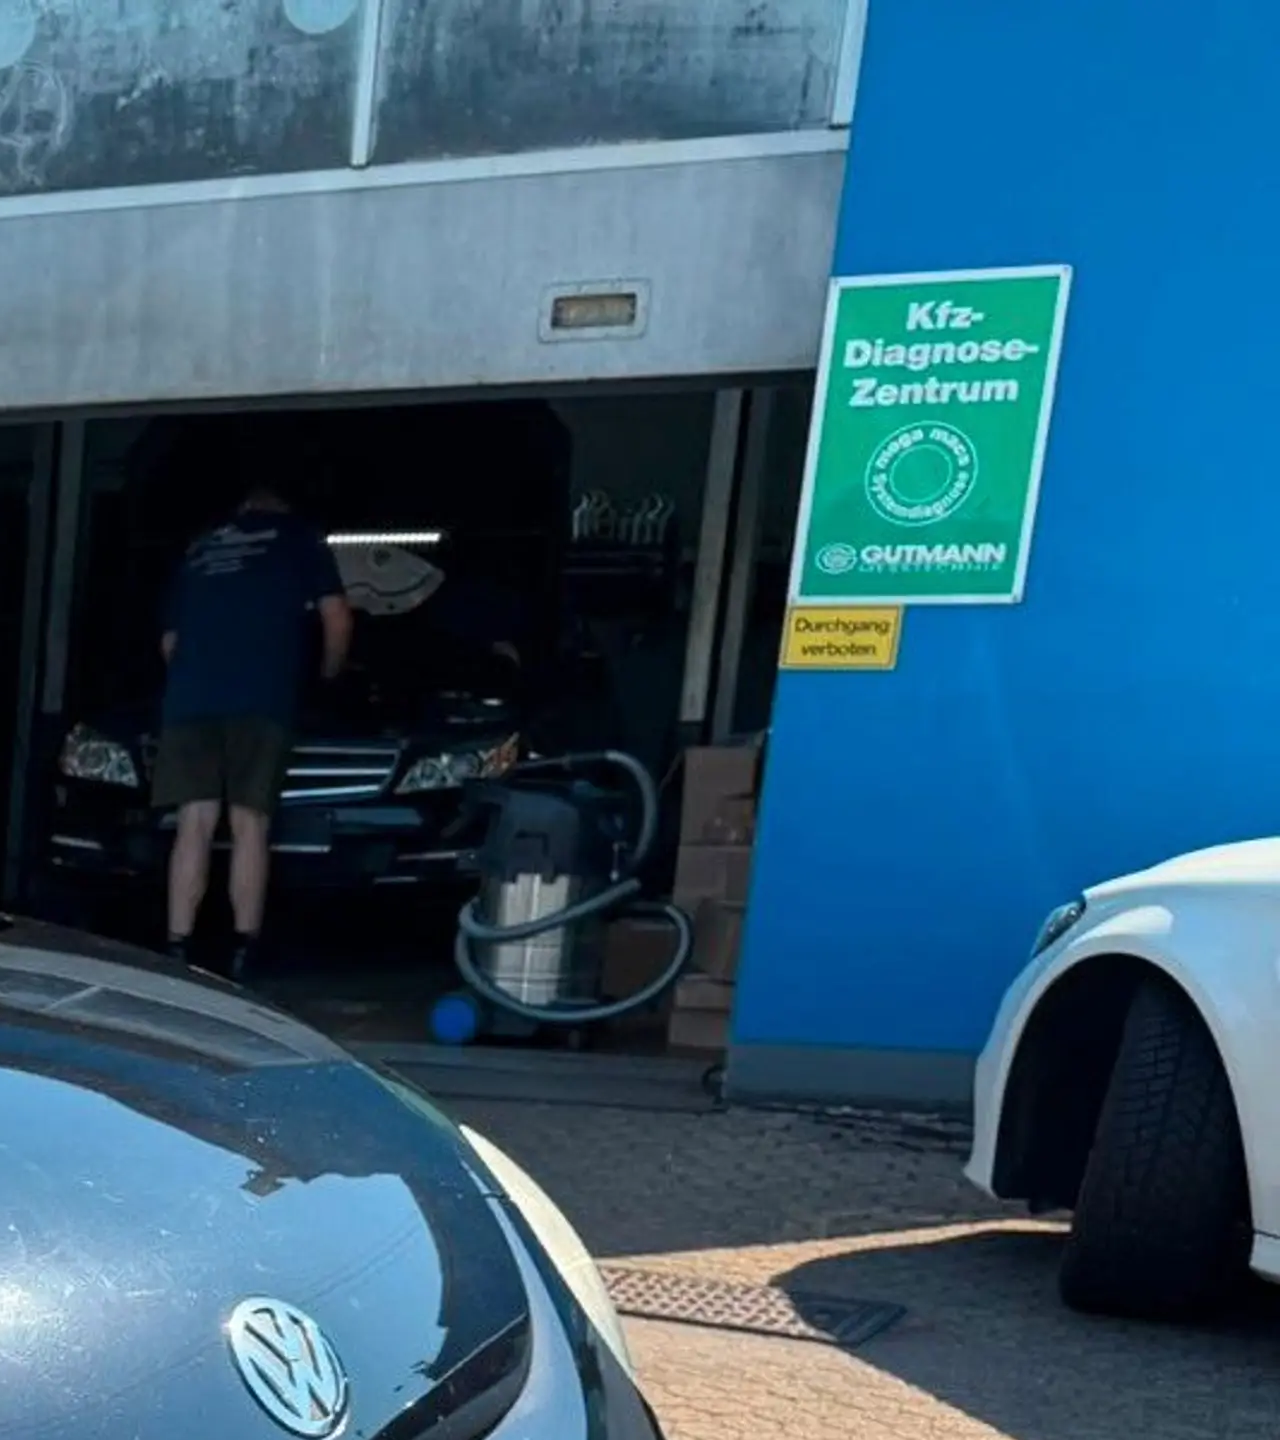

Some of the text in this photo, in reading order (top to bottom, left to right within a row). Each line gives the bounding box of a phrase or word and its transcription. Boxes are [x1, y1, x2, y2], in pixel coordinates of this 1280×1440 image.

[906, 300, 985, 331] Kfz-
[843, 337, 1039, 371] Diagnose-
[849, 376, 1019, 407] Zentrum
[860, 543, 1007, 564] GUTMANN
[795, 618, 889, 636] Durchgang
[802, 642, 876, 656] verboten
